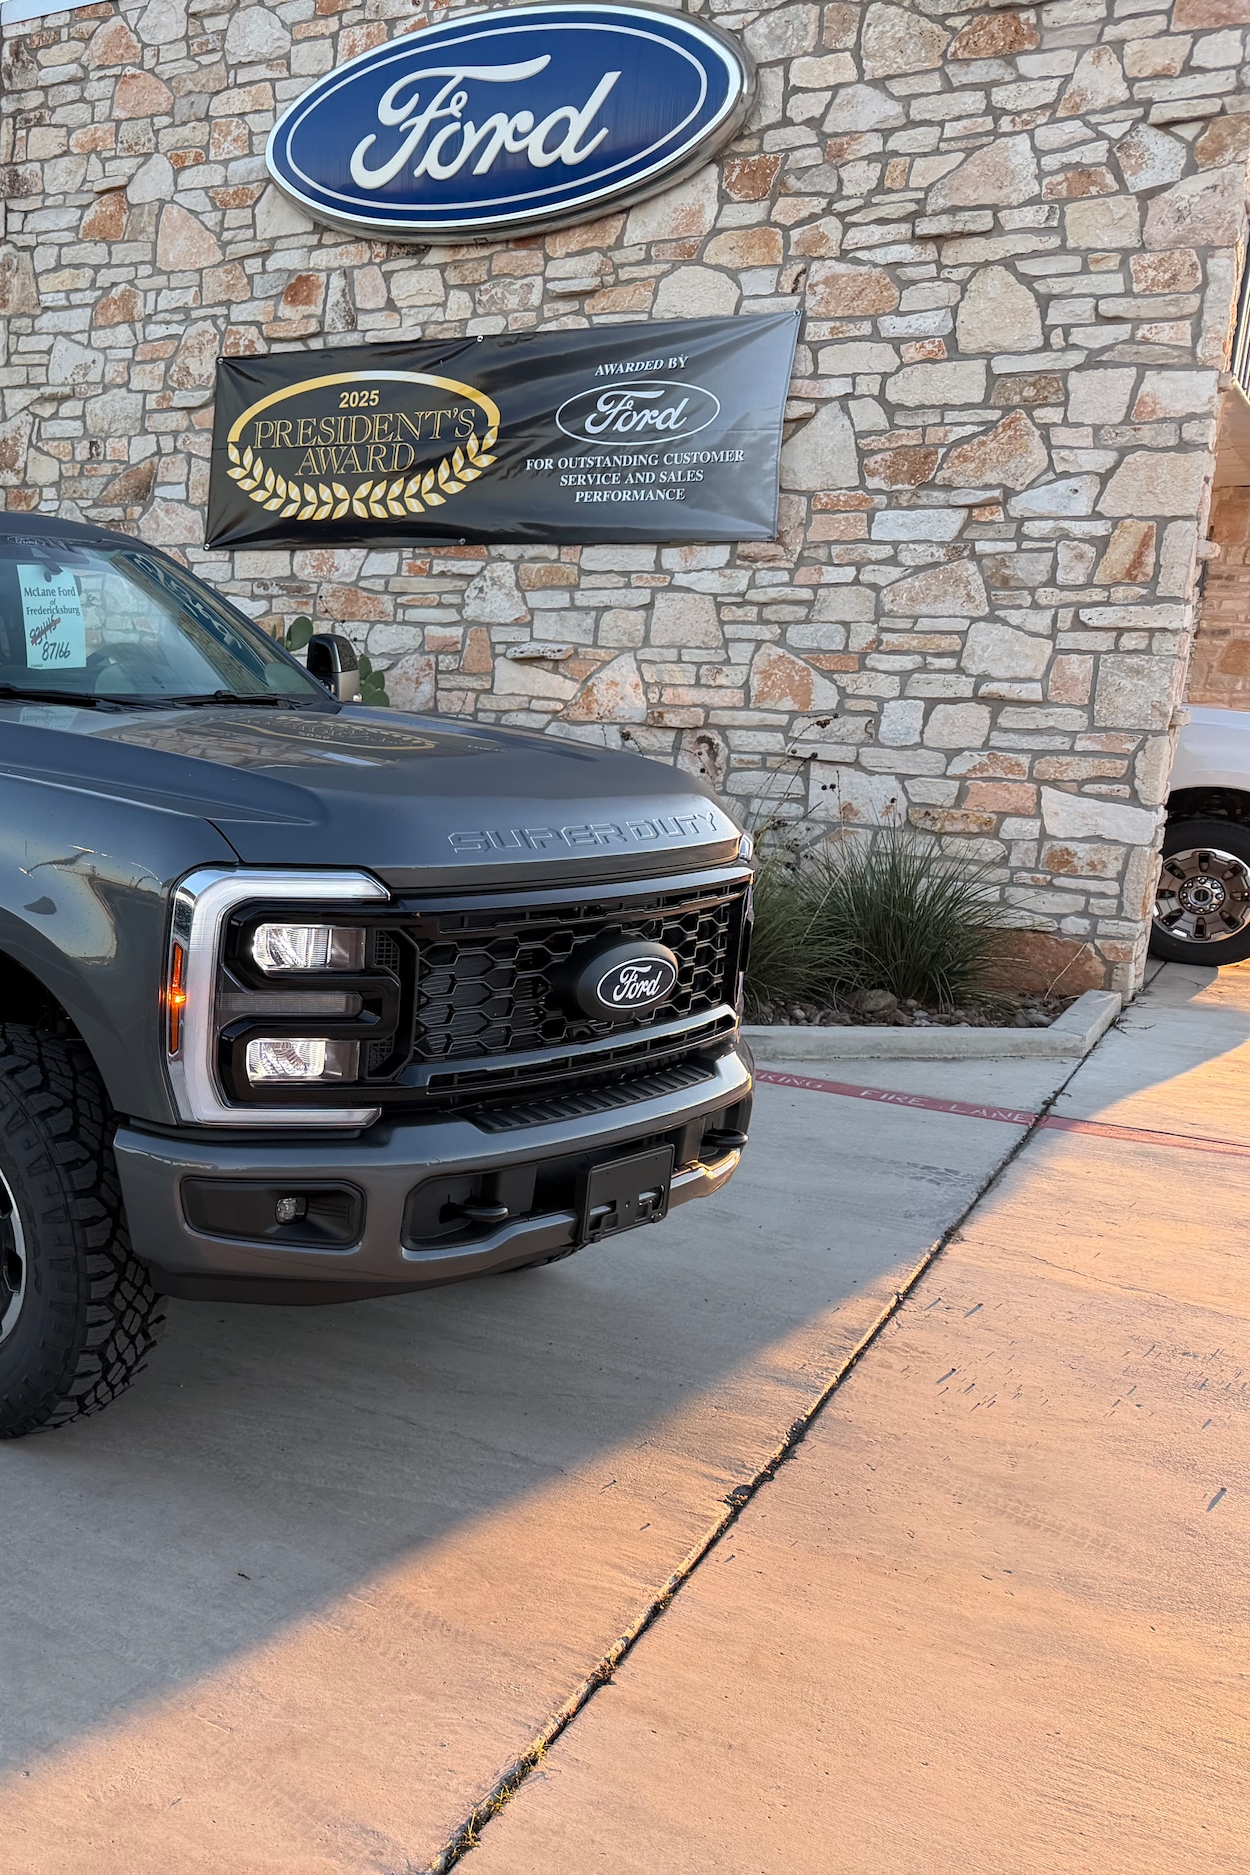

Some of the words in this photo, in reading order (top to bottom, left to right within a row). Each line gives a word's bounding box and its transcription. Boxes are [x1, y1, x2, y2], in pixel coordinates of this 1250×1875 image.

[350, 54, 622, 190] Ford
[595, 358, 664, 377] AWARDED
[667, 355, 690, 370] BY
[338, 389, 380, 409] 2025
[584, 389, 690, 434] Ford
[253, 408, 475, 449] PRESIDENT'S
[294, 442, 415, 476] AWARD
[525, 458, 554, 471] FOR
[557, 454, 659, 470] OUTSTANDING
[663, 449, 745, 466] CUSTOMER
[559, 472, 621, 487] SERVICE
[624, 471, 656, 485] AND
[659, 469, 704, 484] SALES
[574, 488, 686, 503] PERFORMANCE
[23, 587, 56, 597] McLane
[57, 586, 77, 597] Ford
[49, 598, 56, 606] of
[26, 606, 81, 616] Fredericksburg
[42, 641, 71, 661] 87166
[447, 822, 627, 853] SUPER
[629, 811, 717, 841] DUTY
[613, 964, 663, 1002] Ford
[859, 1089, 929, 1107] FIRE
[949, 1104, 1033, 1125] LANE
